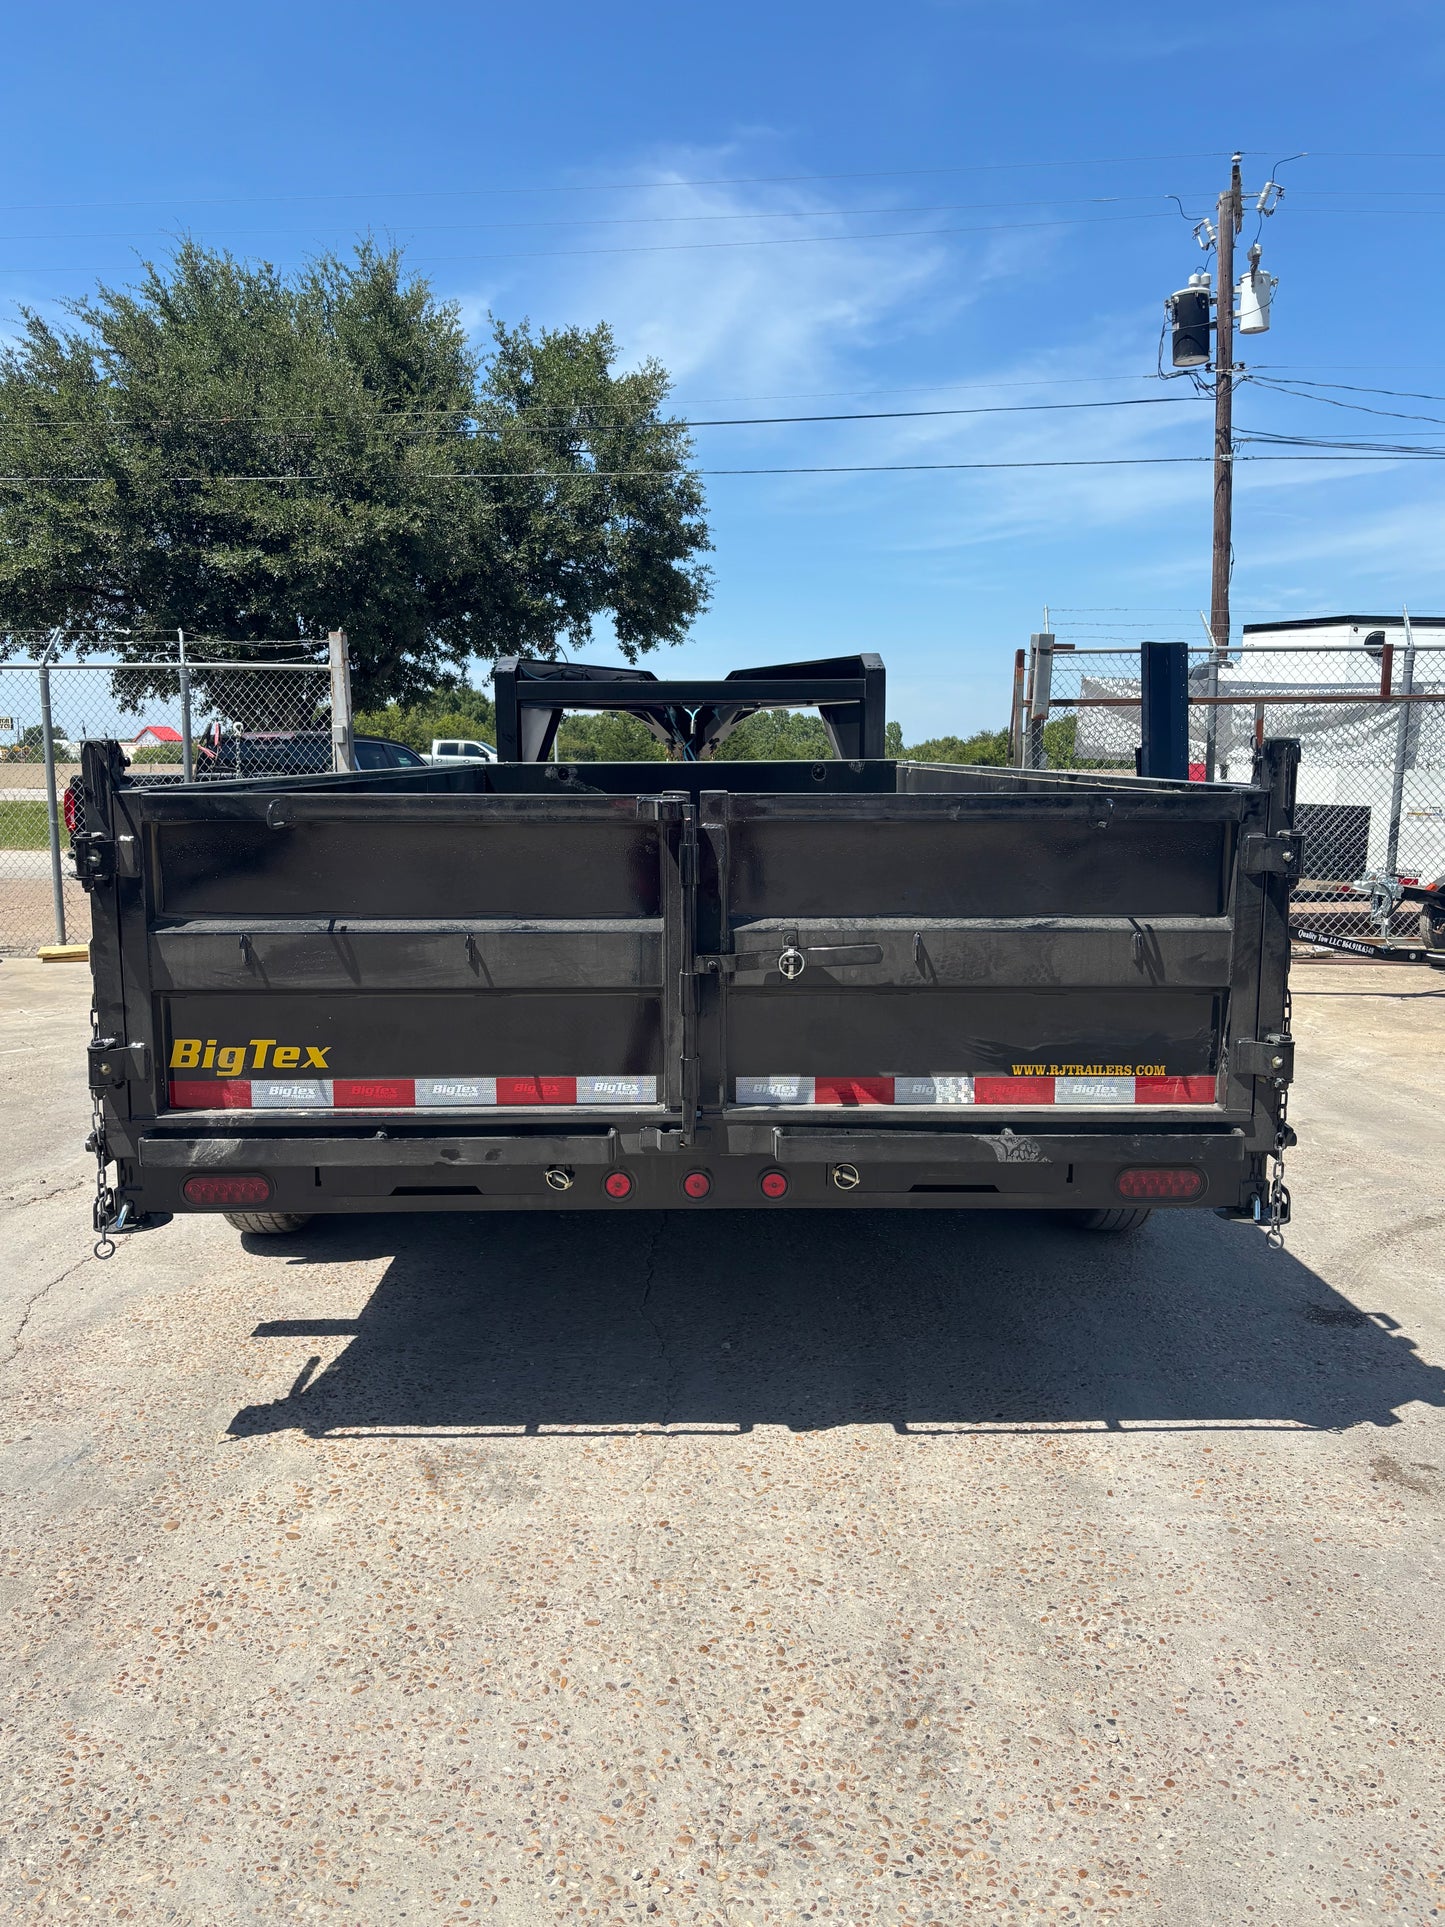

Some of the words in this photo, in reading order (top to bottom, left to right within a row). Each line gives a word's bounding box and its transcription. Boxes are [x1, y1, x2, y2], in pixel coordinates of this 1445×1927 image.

[1298, 929, 1317, 942] Quality
[1318, 934, 1328, 943] Tow
[1329, 937, 1342, 946] LLC
[169, 1039, 332, 1077] BigTex
[1011, 1064, 1167, 1076] WWW.RJTRAILERS.COM
[269, 1086, 316, 1097] BigTex
[351, 1085, 398, 1097] BigTex
[432, 1084, 479, 1096] BigTex
[594, 1082, 639, 1094] BigTex
[753, 1084, 798, 1095] BigTex
[1072, 1084, 1119, 1096] BigTex
